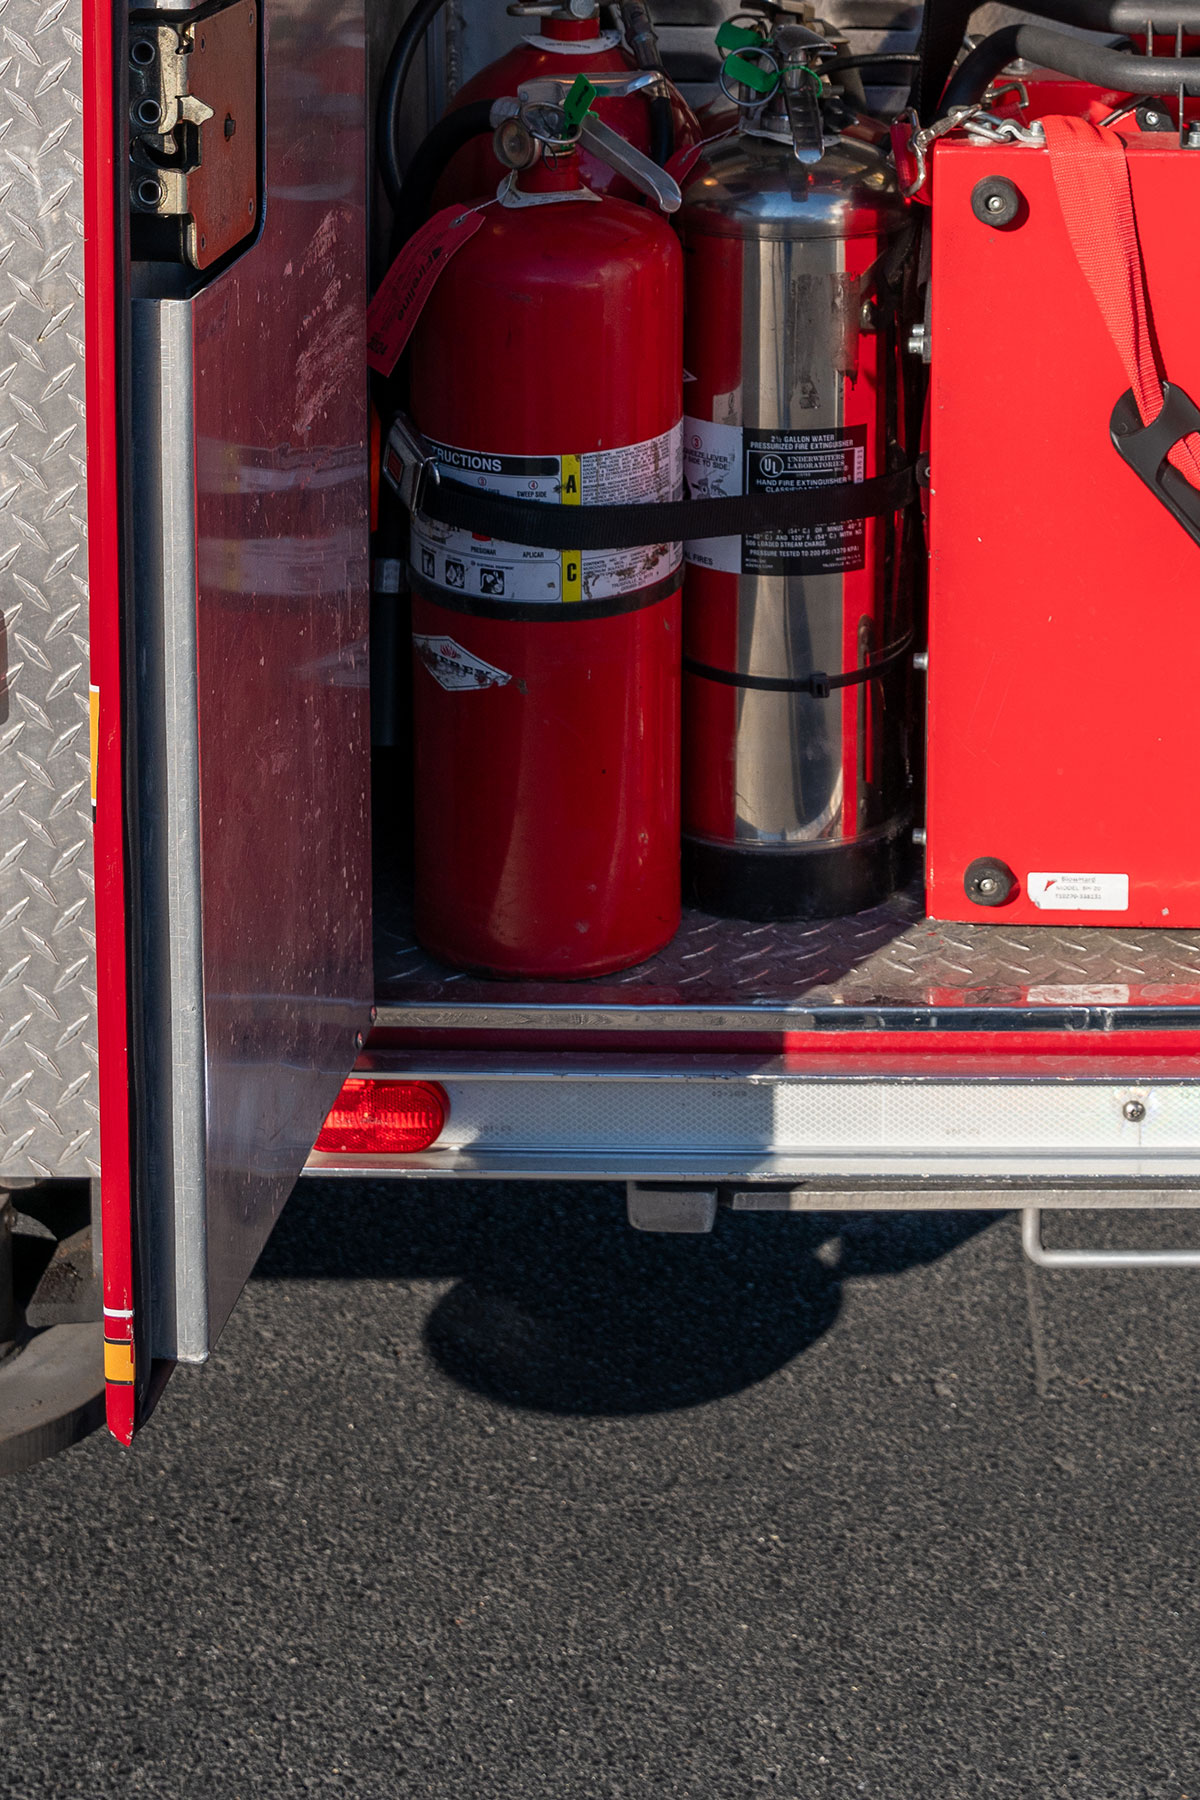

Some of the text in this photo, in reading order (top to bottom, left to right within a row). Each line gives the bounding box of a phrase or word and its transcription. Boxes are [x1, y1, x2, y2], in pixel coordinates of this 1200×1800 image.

[783, 435, 810, 443] GALLON
[811, 433, 835, 443] WATER
[750, 439, 854, 450] PRESSURIZED FIRE EXTINGUISHER
[431, 444, 503, 473] TRUCTIONS
[787, 453, 845, 463] UNDERWRITERS
[566, 474, 577, 494] A
[756, 477, 848, 487] HAND FIRE EXTINGUISHER
[757, 540, 780, 548] LOADED
[780, 540, 804, 548] STREAM
[749, 549, 778, 558] PRESSURE
[779, 549, 800, 558] TESTED
[801, 549, 809, 557] TO
[809, 549, 821, 557] 200
[567, 563, 577, 582] C
